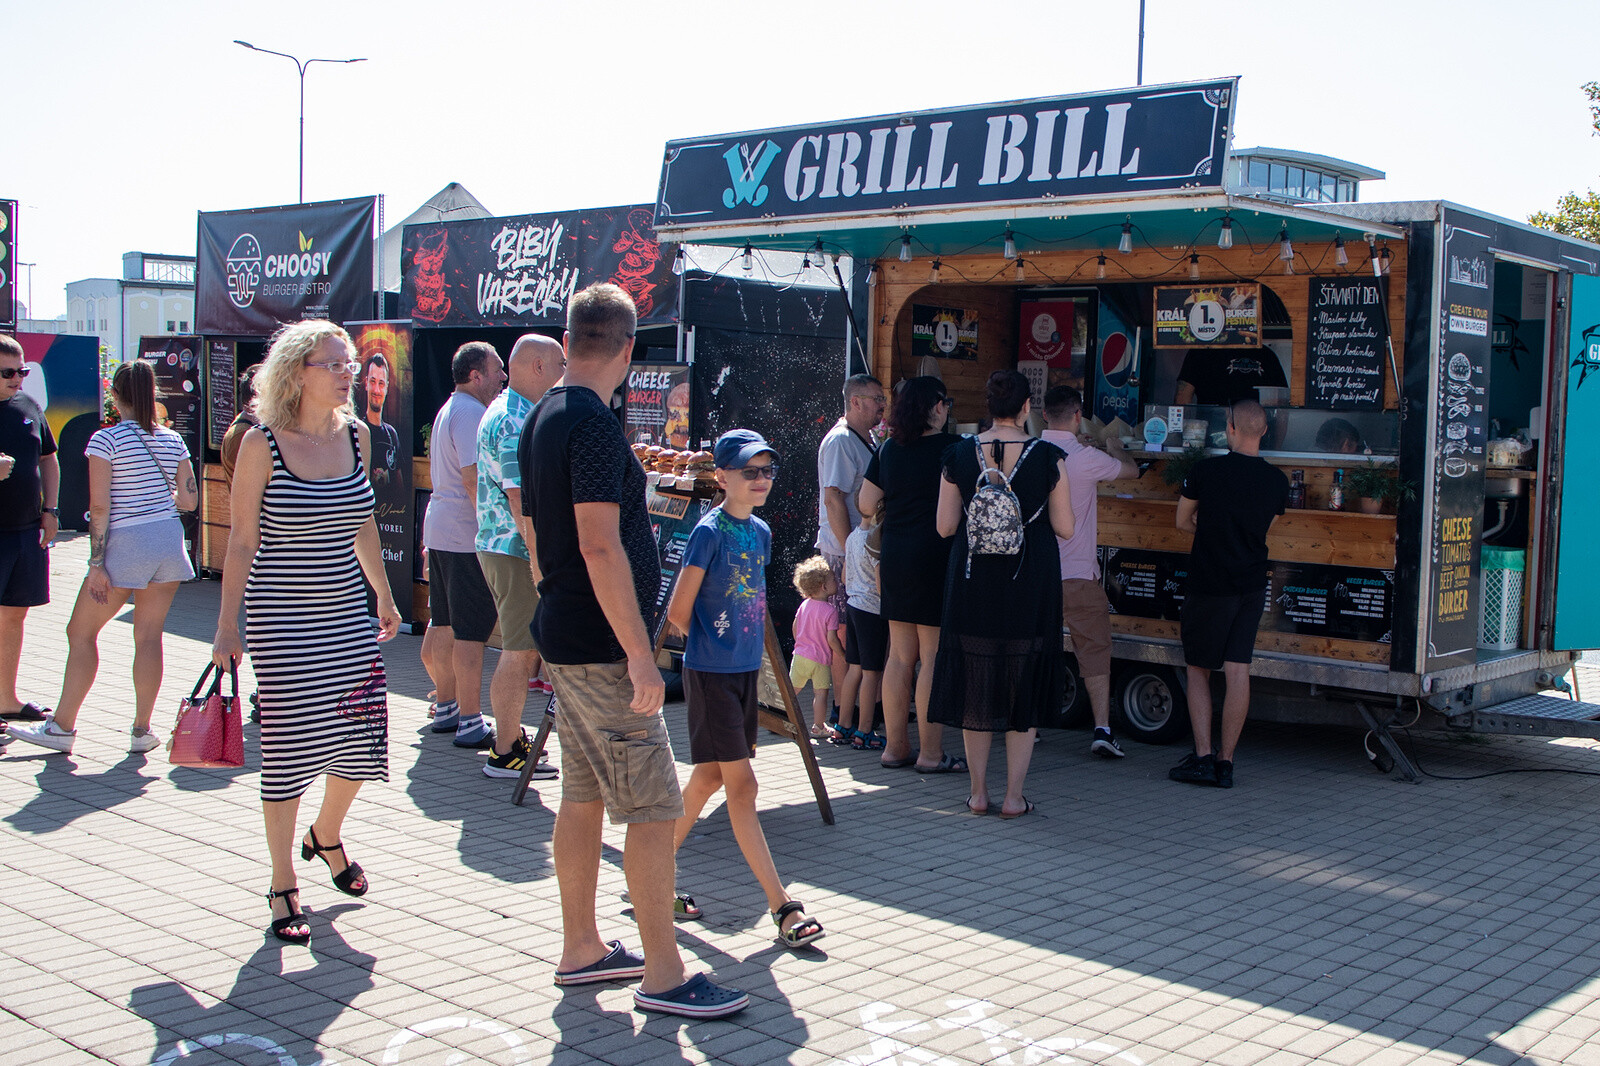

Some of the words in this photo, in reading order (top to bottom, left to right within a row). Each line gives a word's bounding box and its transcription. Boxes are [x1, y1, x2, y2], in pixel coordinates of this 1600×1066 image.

[783, 120, 959, 202] GRILL
[978, 102, 1140, 186] BILL
[491, 218, 563, 270] BLBÝ
[264, 252, 332, 278] CHOOSY
[263, 283, 298, 296] BURGER
[299, 282, 331, 295] BISTRO
[1363, 286, 1379, 305] DEN
[1157, 307, 1186, 321] KRÁL
[1201, 305, 1215, 324] 1.
[1450, 303, 1472, 317] CREATE
[1473, 306, 1488, 319] YOUR
[913, 323, 934, 335] KRÁL
[942, 323, 952, 340] 1.
[1198, 325, 1216, 333] MÍSTO
[1450, 319, 1464, 331] OWN
[1465, 321, 1486, 333] BURGER
[1492, 331, 1508, 344] LL
[628, 371, 671, 389] CHEESE
[627, 389, 662, 405] BURGER
[1102, 394, 1130, 411] pepsi
[379, 523, 404, 533] VOREL
[1442, 516, 1473, 542] CHEESE
[381, 548, 404, 562] Chef
[1439, 571, 1454, 591] BEEF
[1438, 589, 1469, 617] BURGER
[714, 620, 730, 628] 025
